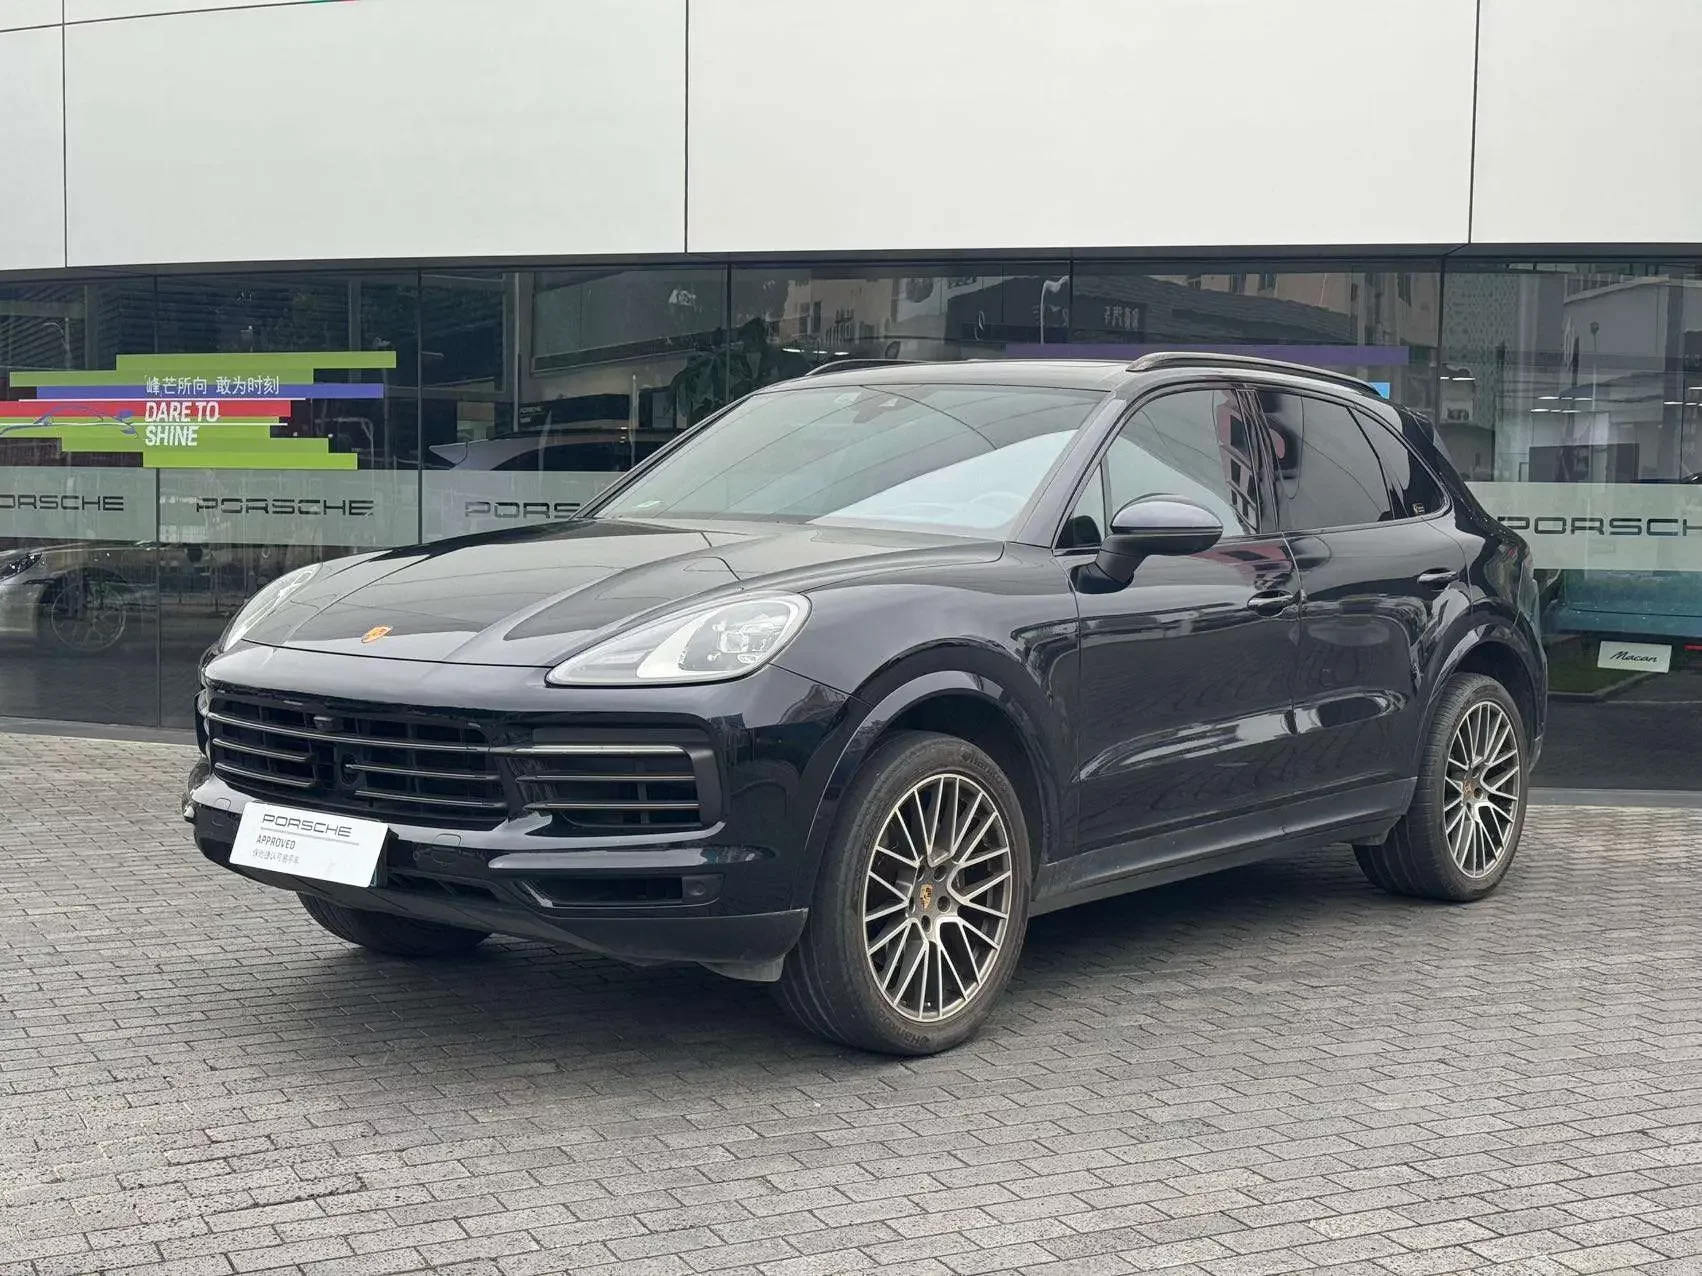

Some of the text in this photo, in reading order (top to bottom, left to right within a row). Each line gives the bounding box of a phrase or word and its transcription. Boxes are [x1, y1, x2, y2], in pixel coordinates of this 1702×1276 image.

[145, 375, 279, 395] 峰芒所向 敢为时刻
[144, 401, 219, 422] DARE TO
[144, 425, 199, 446] SHINE
[196, 498, 374, 516] PORSCHE
[1609, 650, 1658, 663] Macan
[262, 813, 352, 838] PORSCHE
[256, 834, 296, 849] APPROVED
